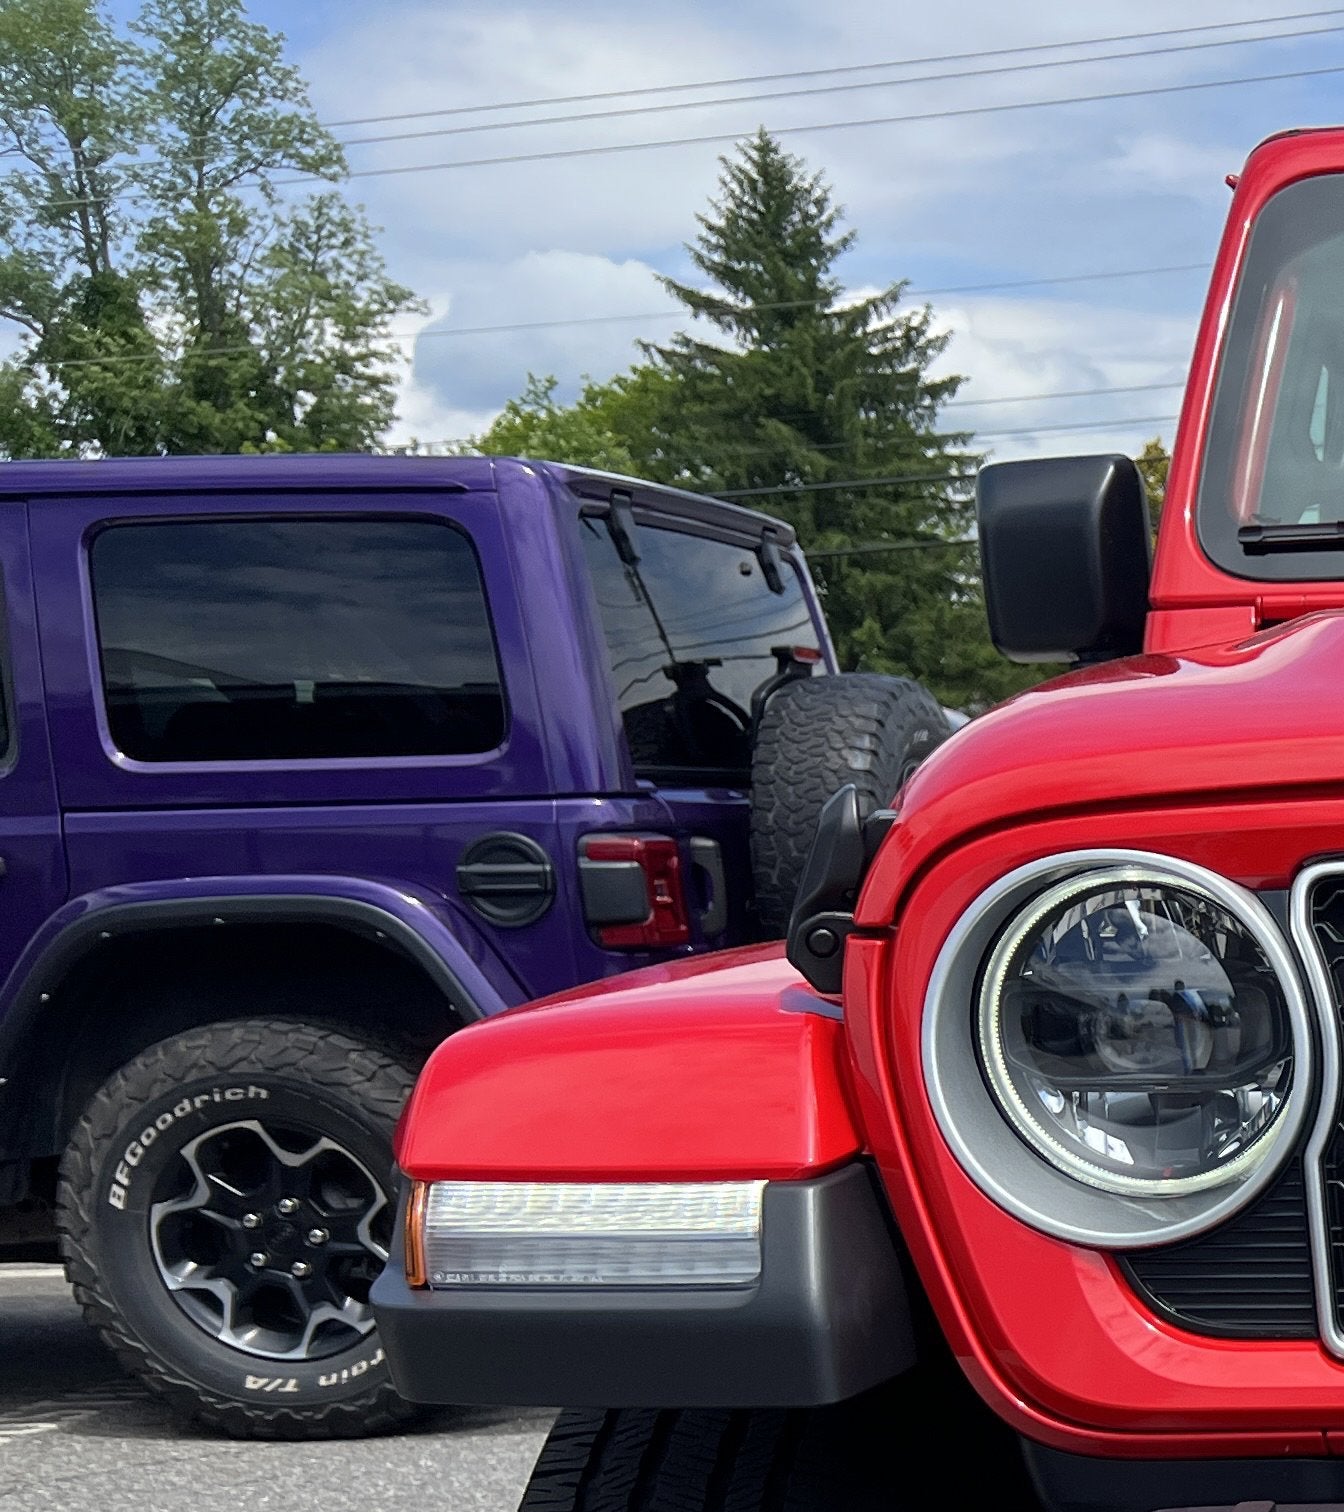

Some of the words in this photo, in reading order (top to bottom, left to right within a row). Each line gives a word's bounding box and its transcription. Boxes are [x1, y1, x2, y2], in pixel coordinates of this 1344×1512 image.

[108, 1084, 271, 1210] BFGoodrich
[243, 1373, 299, 1392] T/A
[318, 1347, 385, 1388] rain
